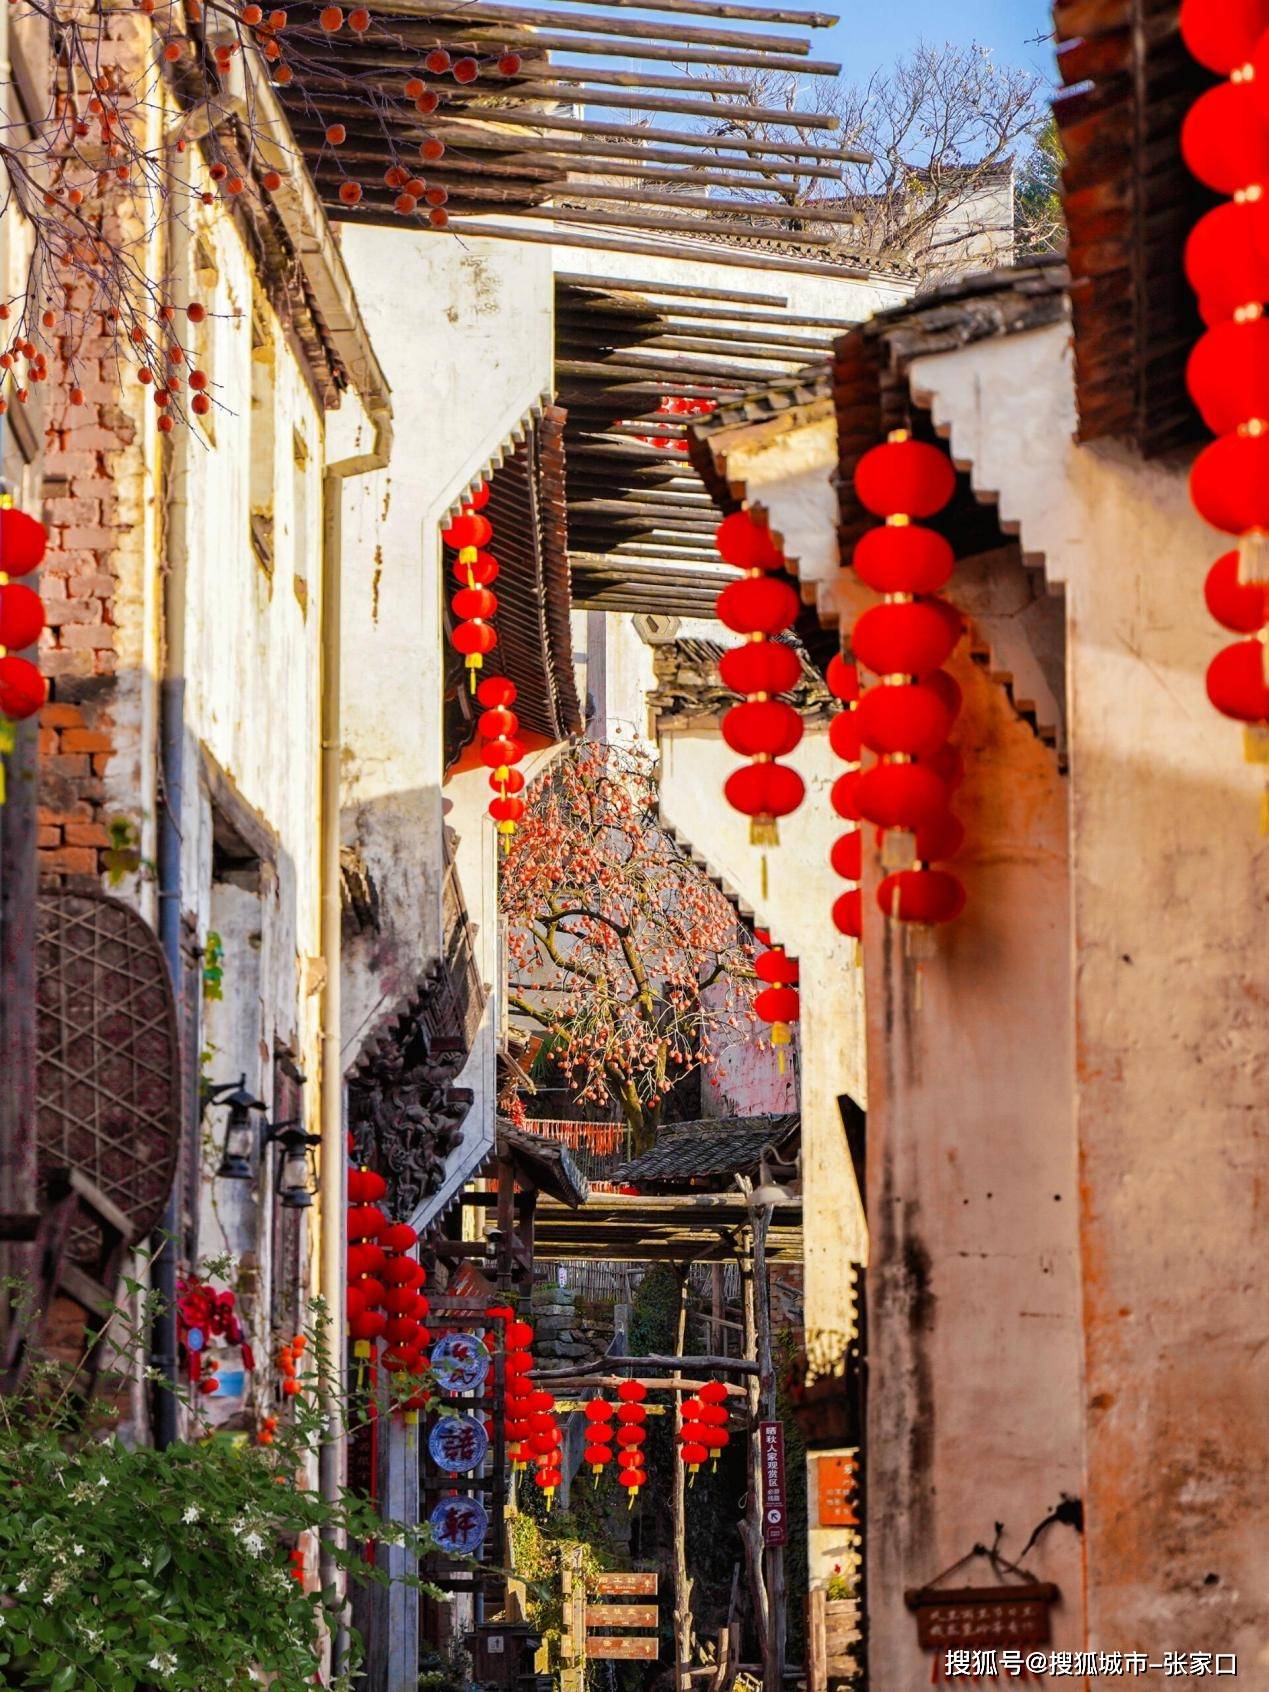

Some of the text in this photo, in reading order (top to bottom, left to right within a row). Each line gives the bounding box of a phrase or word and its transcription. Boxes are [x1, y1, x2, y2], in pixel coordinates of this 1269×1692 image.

[765, 1426, 778, 1487] 晒秋人家观赏区
